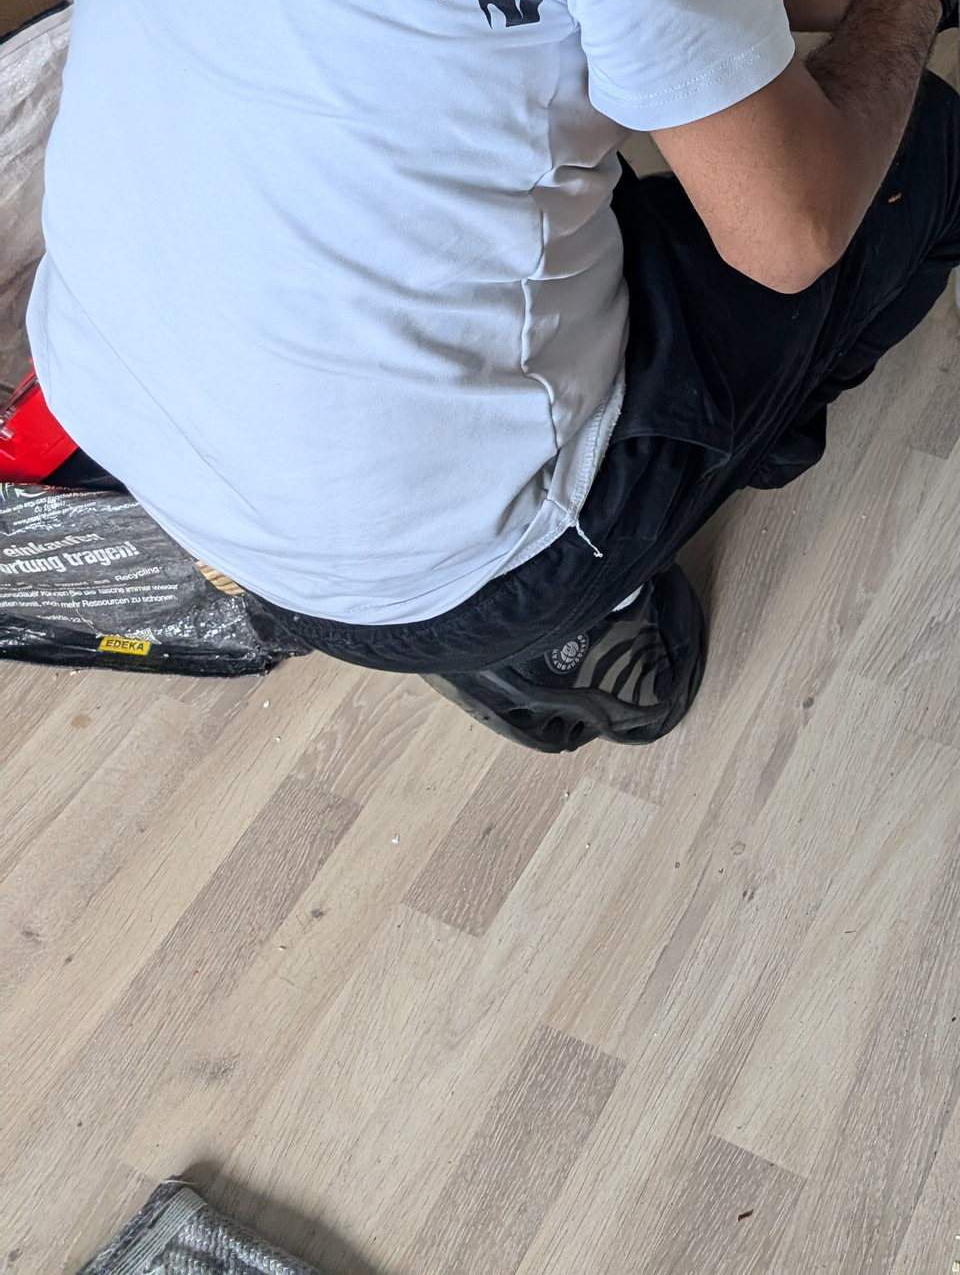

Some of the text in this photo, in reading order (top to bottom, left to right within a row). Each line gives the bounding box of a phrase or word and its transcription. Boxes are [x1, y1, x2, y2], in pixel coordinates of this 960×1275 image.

[3, 533, 105, 557] einkaufen
[62, 541, 140, 566] tragen!
[114, 566, 163, 582] Recycling-
[82, 597, 130, 607] Ressourcen
[105, 639, 145, 651] EDEKA
